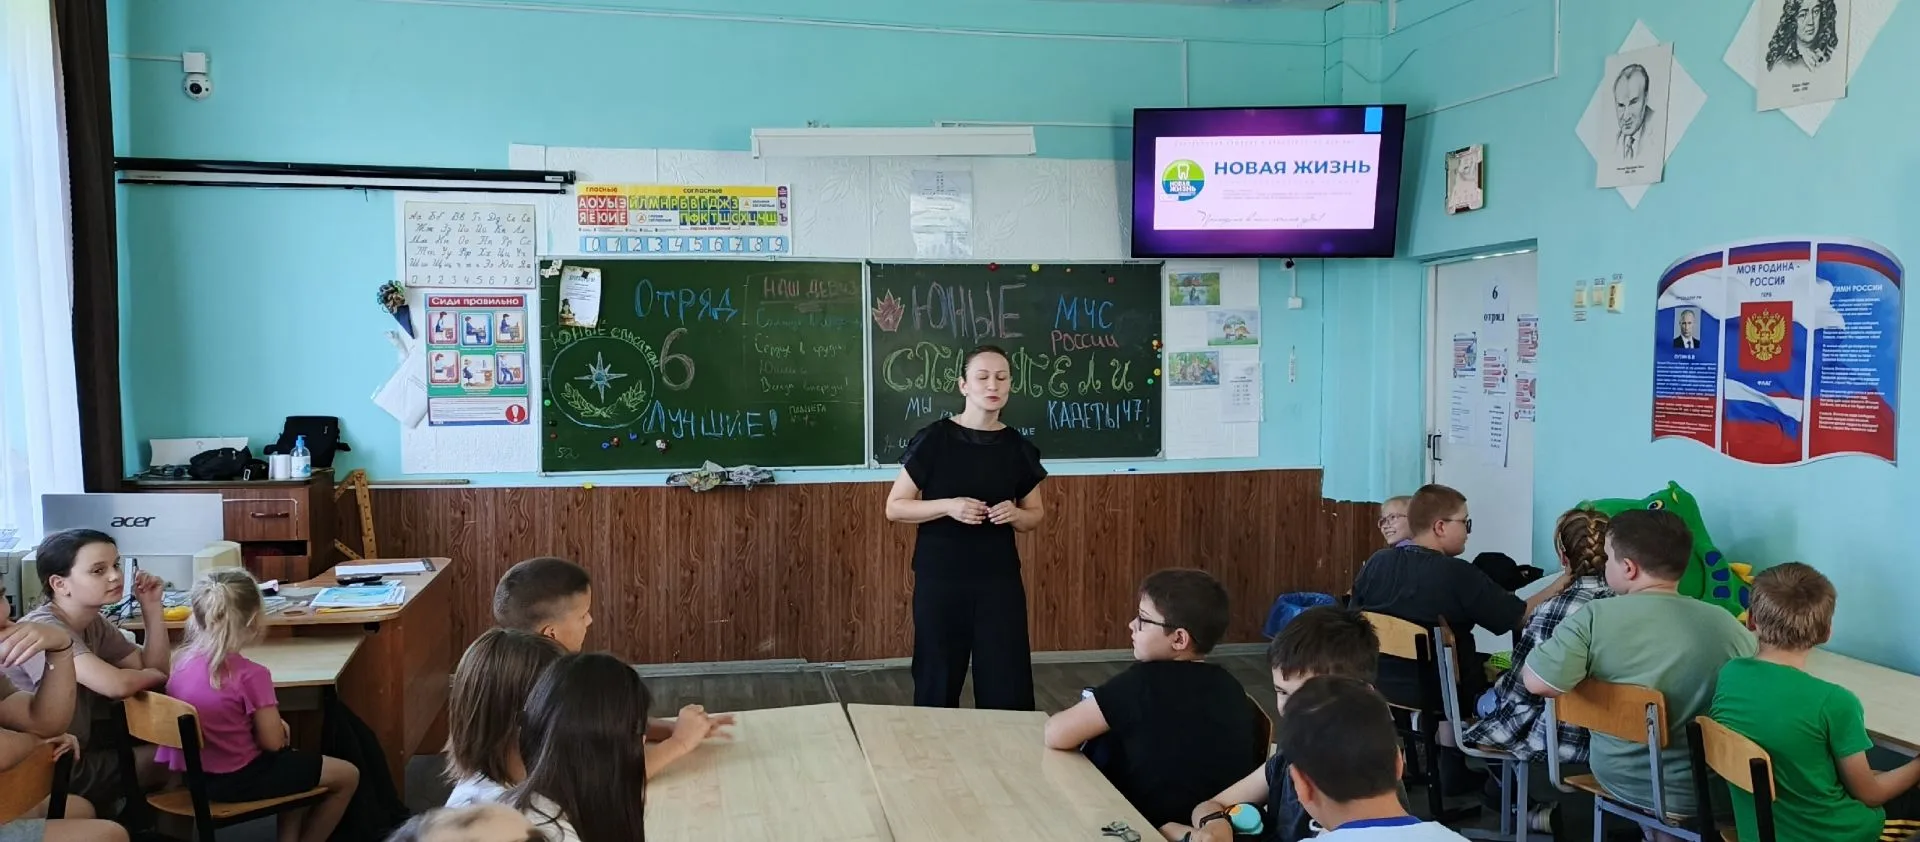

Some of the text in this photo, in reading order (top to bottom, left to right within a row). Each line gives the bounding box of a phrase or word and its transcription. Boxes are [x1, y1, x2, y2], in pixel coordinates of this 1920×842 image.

[1214, 159, 1371, 175] НОВАЯ ЖИЗНЬ
[1736, 264, 1756, 275] МОЯ
[1758, 261, 1795, 274] РОДИНА
[1750, 275, 1786, 287] РОССИЯ
[1492, 285, 1499, 300] 6
[431, 297, 520, 306] Сиди правильно
[911, 281, 1026, 344] ЮНЫЕ
[1055, 294, 1114, 331] МЧС
[659, 327, 695, 391] 6
[904, 395, 932, 421] МЫ
[111, 516, 156, 528] acer
